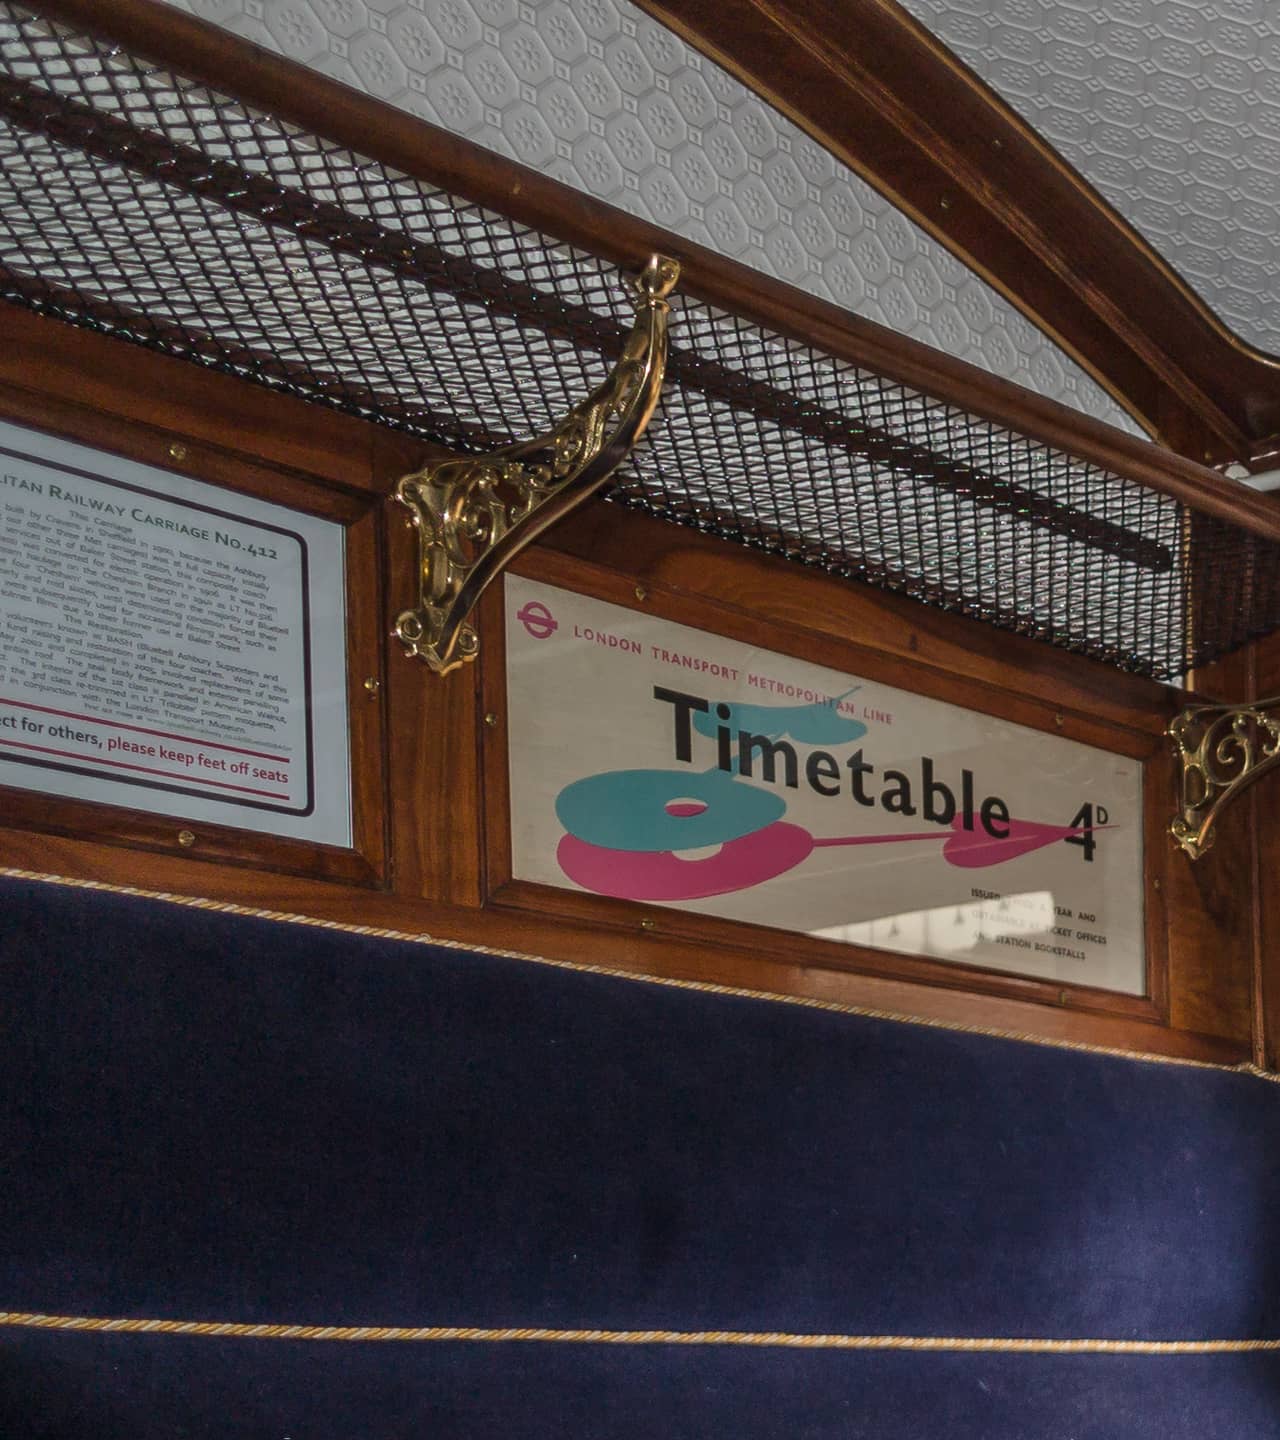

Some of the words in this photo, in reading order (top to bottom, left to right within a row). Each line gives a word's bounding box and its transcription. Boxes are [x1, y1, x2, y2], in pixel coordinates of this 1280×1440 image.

[50, 485, 125, 516] RAILWAY
[132, 509, 208, 540] CARRIAGE
[573, 625, 642, 655] LONDON
[651, 646, 738, 682] TRANSPORT
[747, 674, 855, 714] METROPOLITAN
[864, 707, 893, 725] LINE
[0, 717, 17, 728] ct
[21, 717, 44, 733] for
[48, 726, 102, 748] others,
[108, 736, 155, 756] please
[160, 746, 194, 766] keep
[198, 753, 226, 771] feet
[230, 762, 250, 775] off
[252, 768, 288, 783] seats
[653, 685, 1010, 840] Timetable
[1053, 906, 1072, 918] YEAR
[1078, 911, 1096, 923] AND
[1076, 931, 1107, 945] OFFICES
[1034, 942, 1086, 960] BOOKSTALLS
